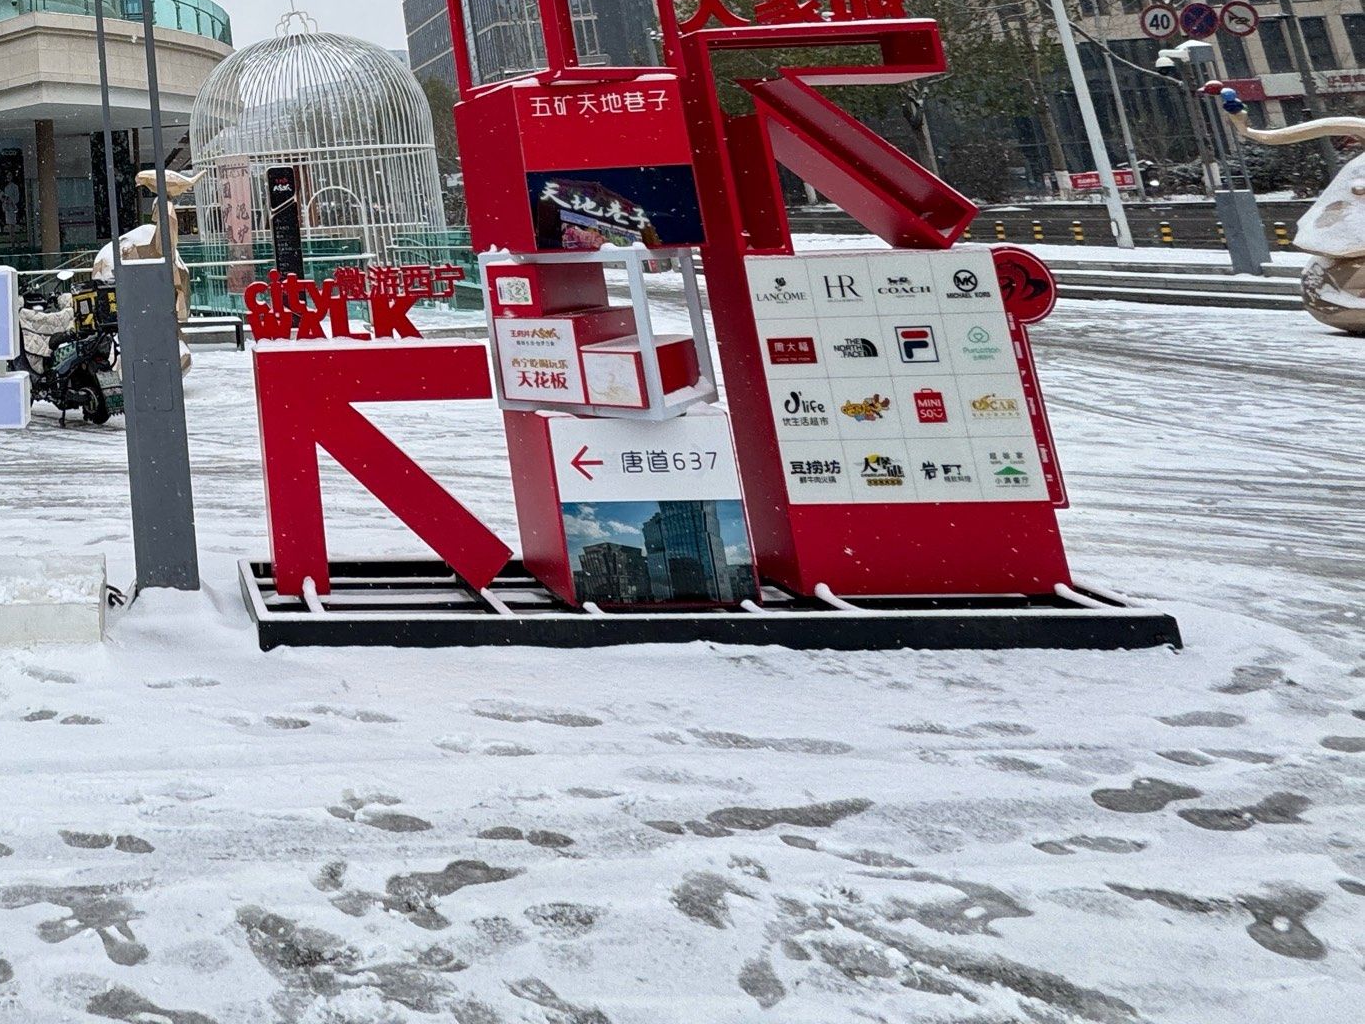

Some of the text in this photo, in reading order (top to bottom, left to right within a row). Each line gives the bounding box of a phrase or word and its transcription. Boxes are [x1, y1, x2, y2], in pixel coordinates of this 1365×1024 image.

[1148, 13, 1170, 31] 40
[529, 90, 668, 117] 五矿天地巷子
[540, 182, 652, 229] 天地巷子
[244, 268, 334, 323] city
[822, 275, 863, 298] HR
[878, 286, 931, 295] COACH
[516, 370, 569, 389] 天花板
[917, 399, 942, 408] MINI
[621, 450, 718, 474] 唐道637
[790, 460, 841, 475] 豆捞坊
